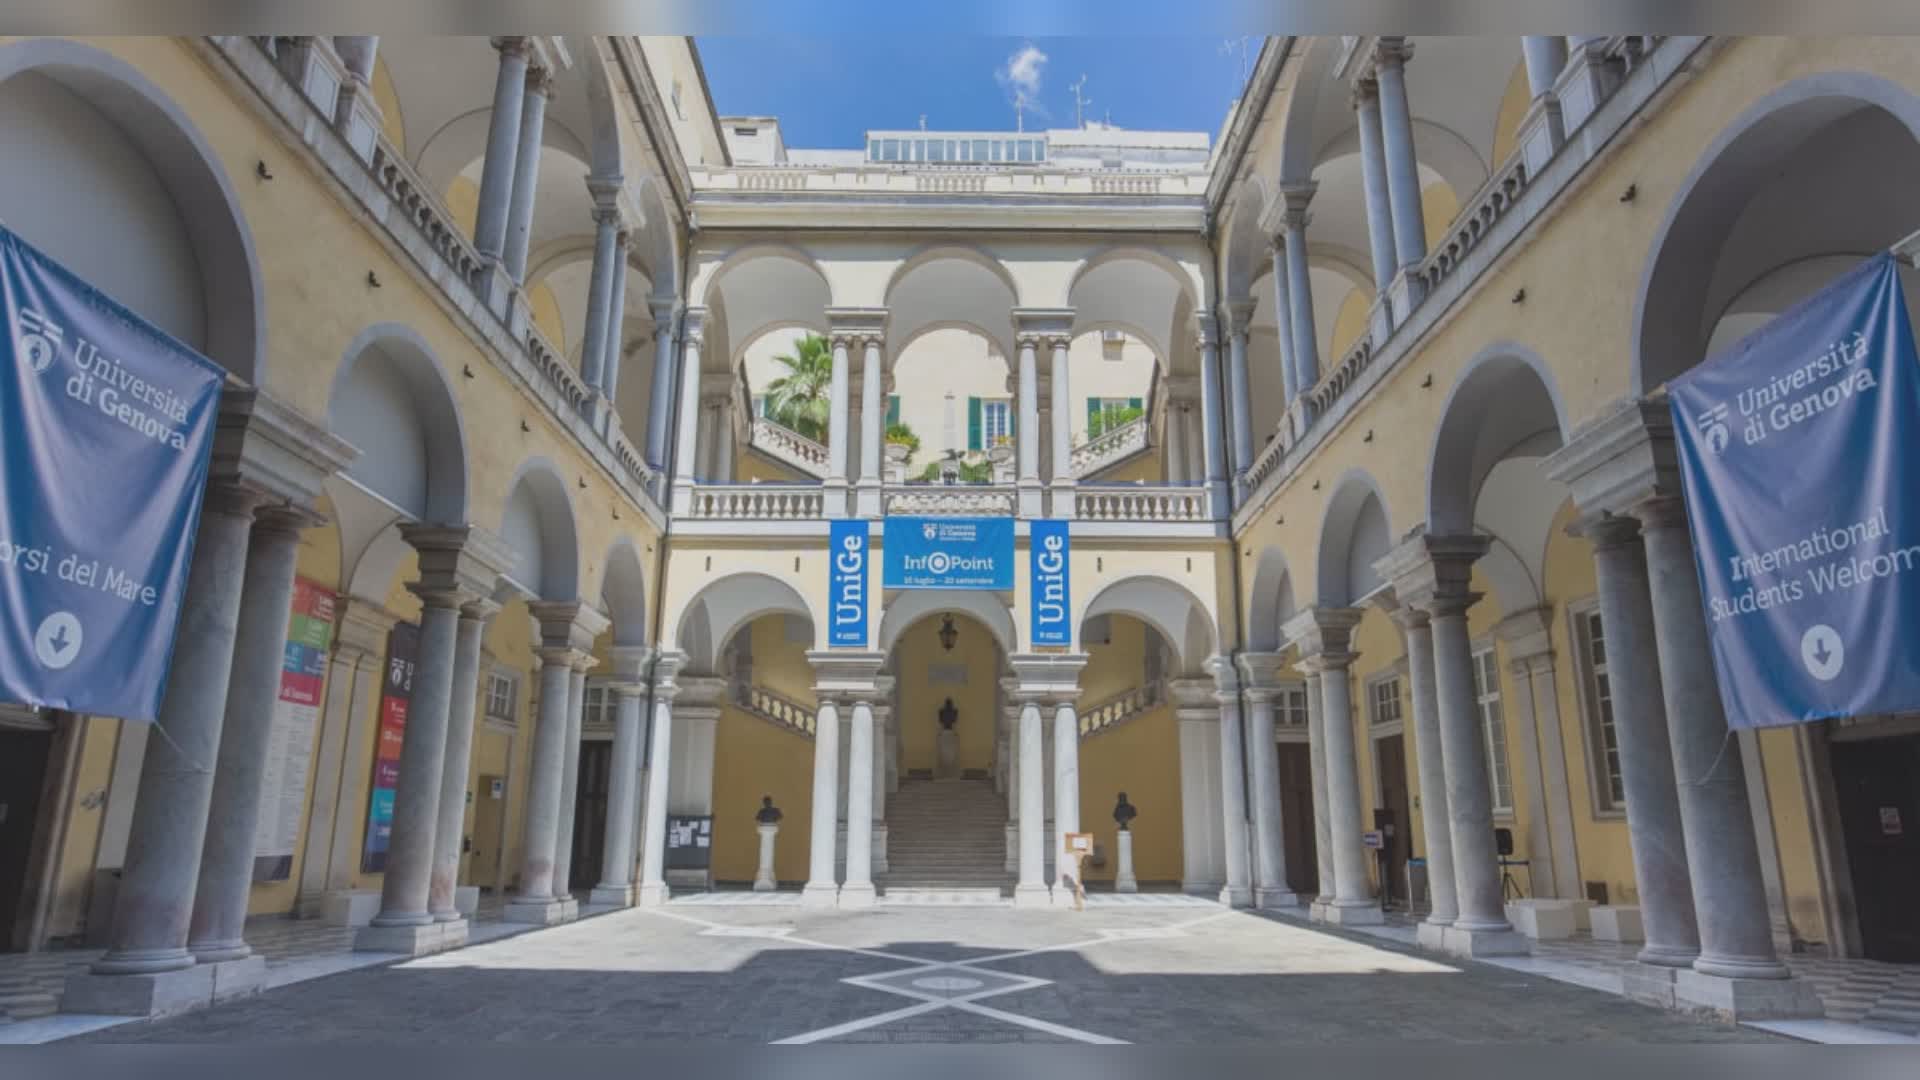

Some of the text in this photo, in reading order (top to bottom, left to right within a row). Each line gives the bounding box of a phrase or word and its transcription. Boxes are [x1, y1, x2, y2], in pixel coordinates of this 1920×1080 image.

[66, 370, 186, 450] di Genova
[1737, 331, 1869, 417] Università
[1743, 367, 1877, 446] di Genova
[58, 553, 98, 588] del
[101, 565, 157, 605] Mare
[836, 535, 862, 625] UniGe
[1037, 535, 1064, 625] UniGe
[1729, 506, 1890, 582] International
[1710, 578, 1804, 621] Students
